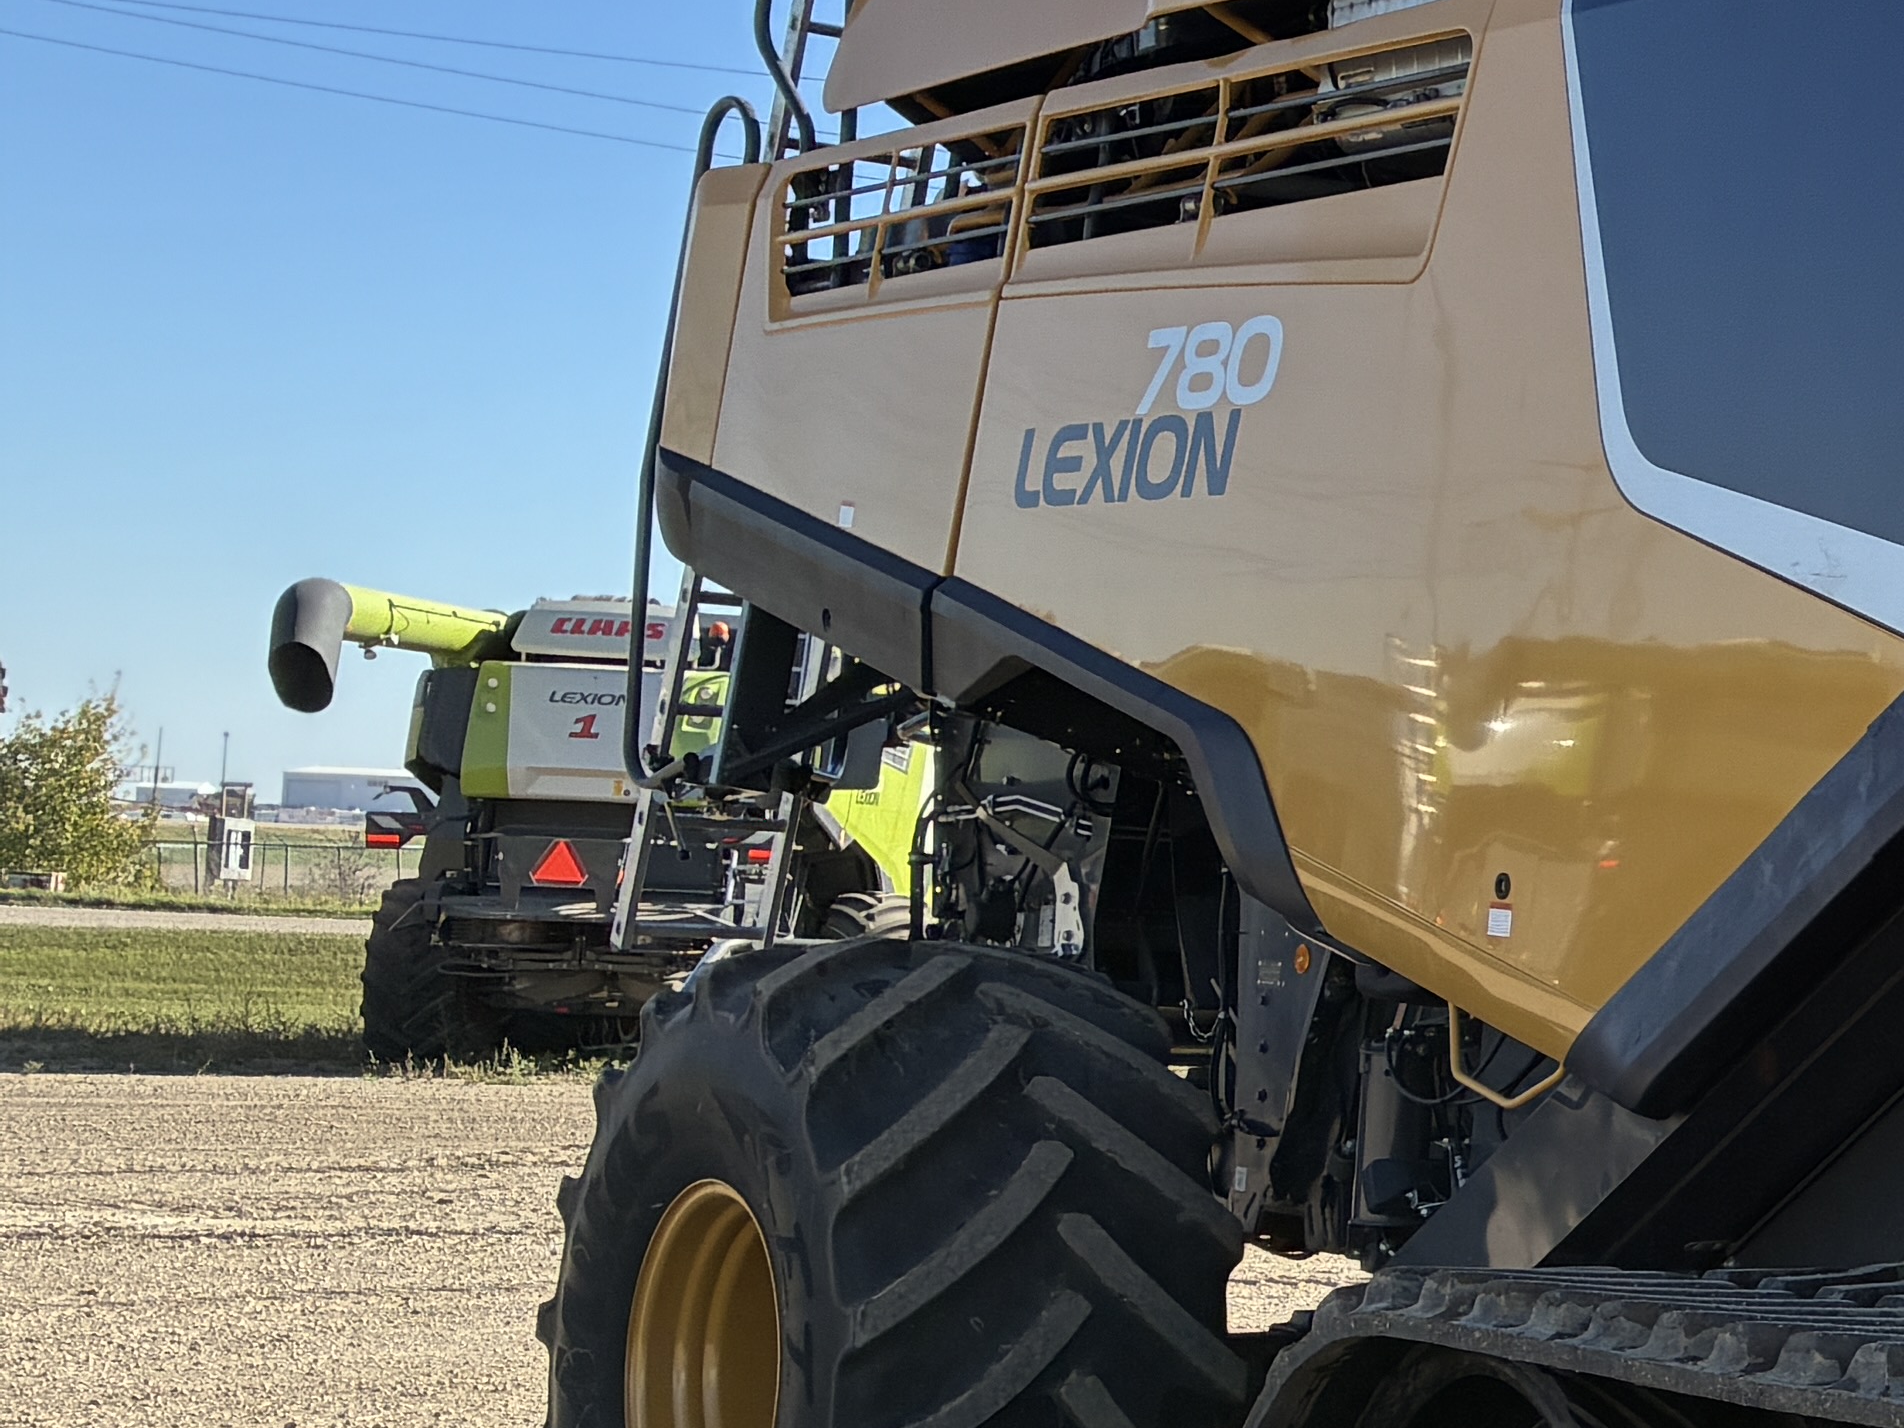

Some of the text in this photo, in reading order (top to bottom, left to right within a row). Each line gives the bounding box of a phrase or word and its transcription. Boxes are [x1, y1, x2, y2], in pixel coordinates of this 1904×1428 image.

[1135, 314, 1283, 415] 780
[1014, 408, 1242, 509] LEXION
[550, 617, 666, 640] CLAAS
[568, 713, 600, 739] 1
